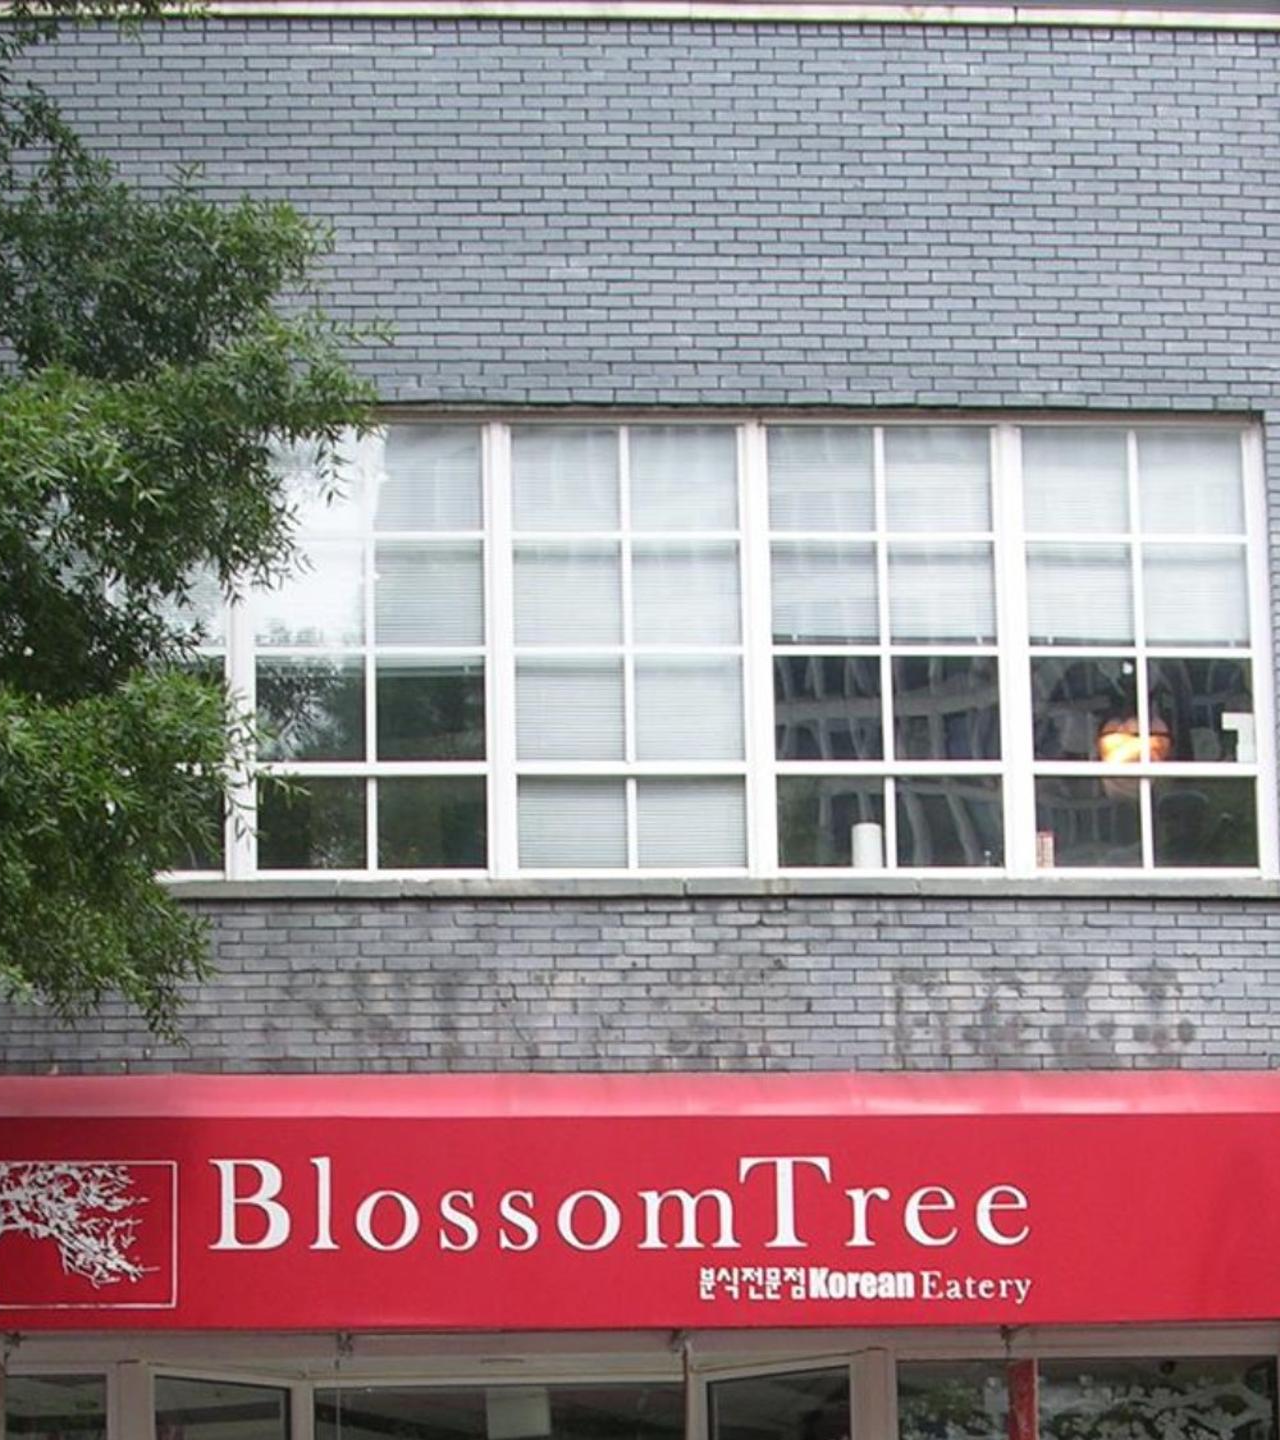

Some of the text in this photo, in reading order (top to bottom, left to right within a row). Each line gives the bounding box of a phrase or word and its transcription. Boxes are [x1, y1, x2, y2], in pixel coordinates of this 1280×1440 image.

[208, 1156, 1031, 1253] BlossomTree
[699, 1267, 806, 1299] 분식전문점
[808, 1267, 1031, 1304] Korean Eatery
